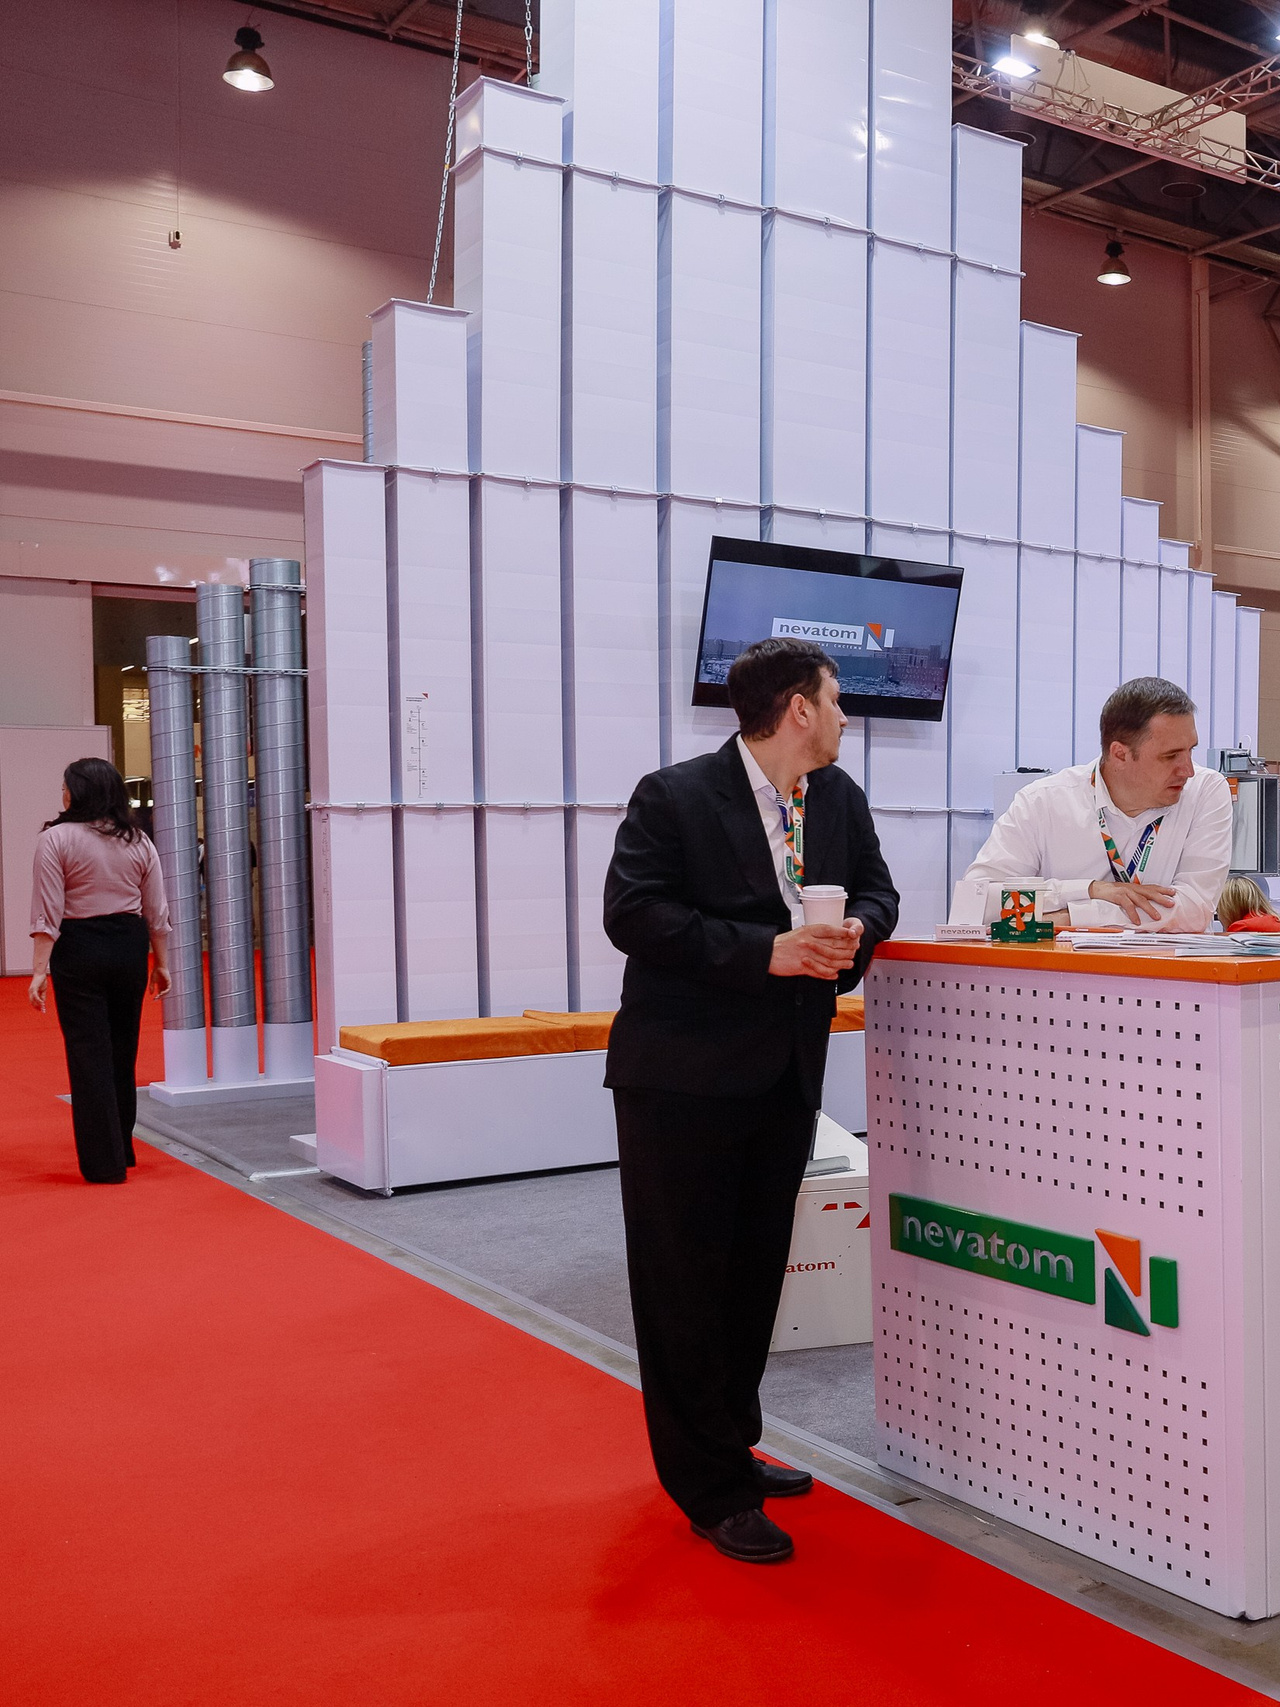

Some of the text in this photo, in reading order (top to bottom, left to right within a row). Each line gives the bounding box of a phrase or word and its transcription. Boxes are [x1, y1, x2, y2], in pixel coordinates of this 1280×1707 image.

[780, 623, 857, 639] nevatom
[903, 1214, 1074, 1283] nevatom
[785, 1261, 836, 1273] atom
